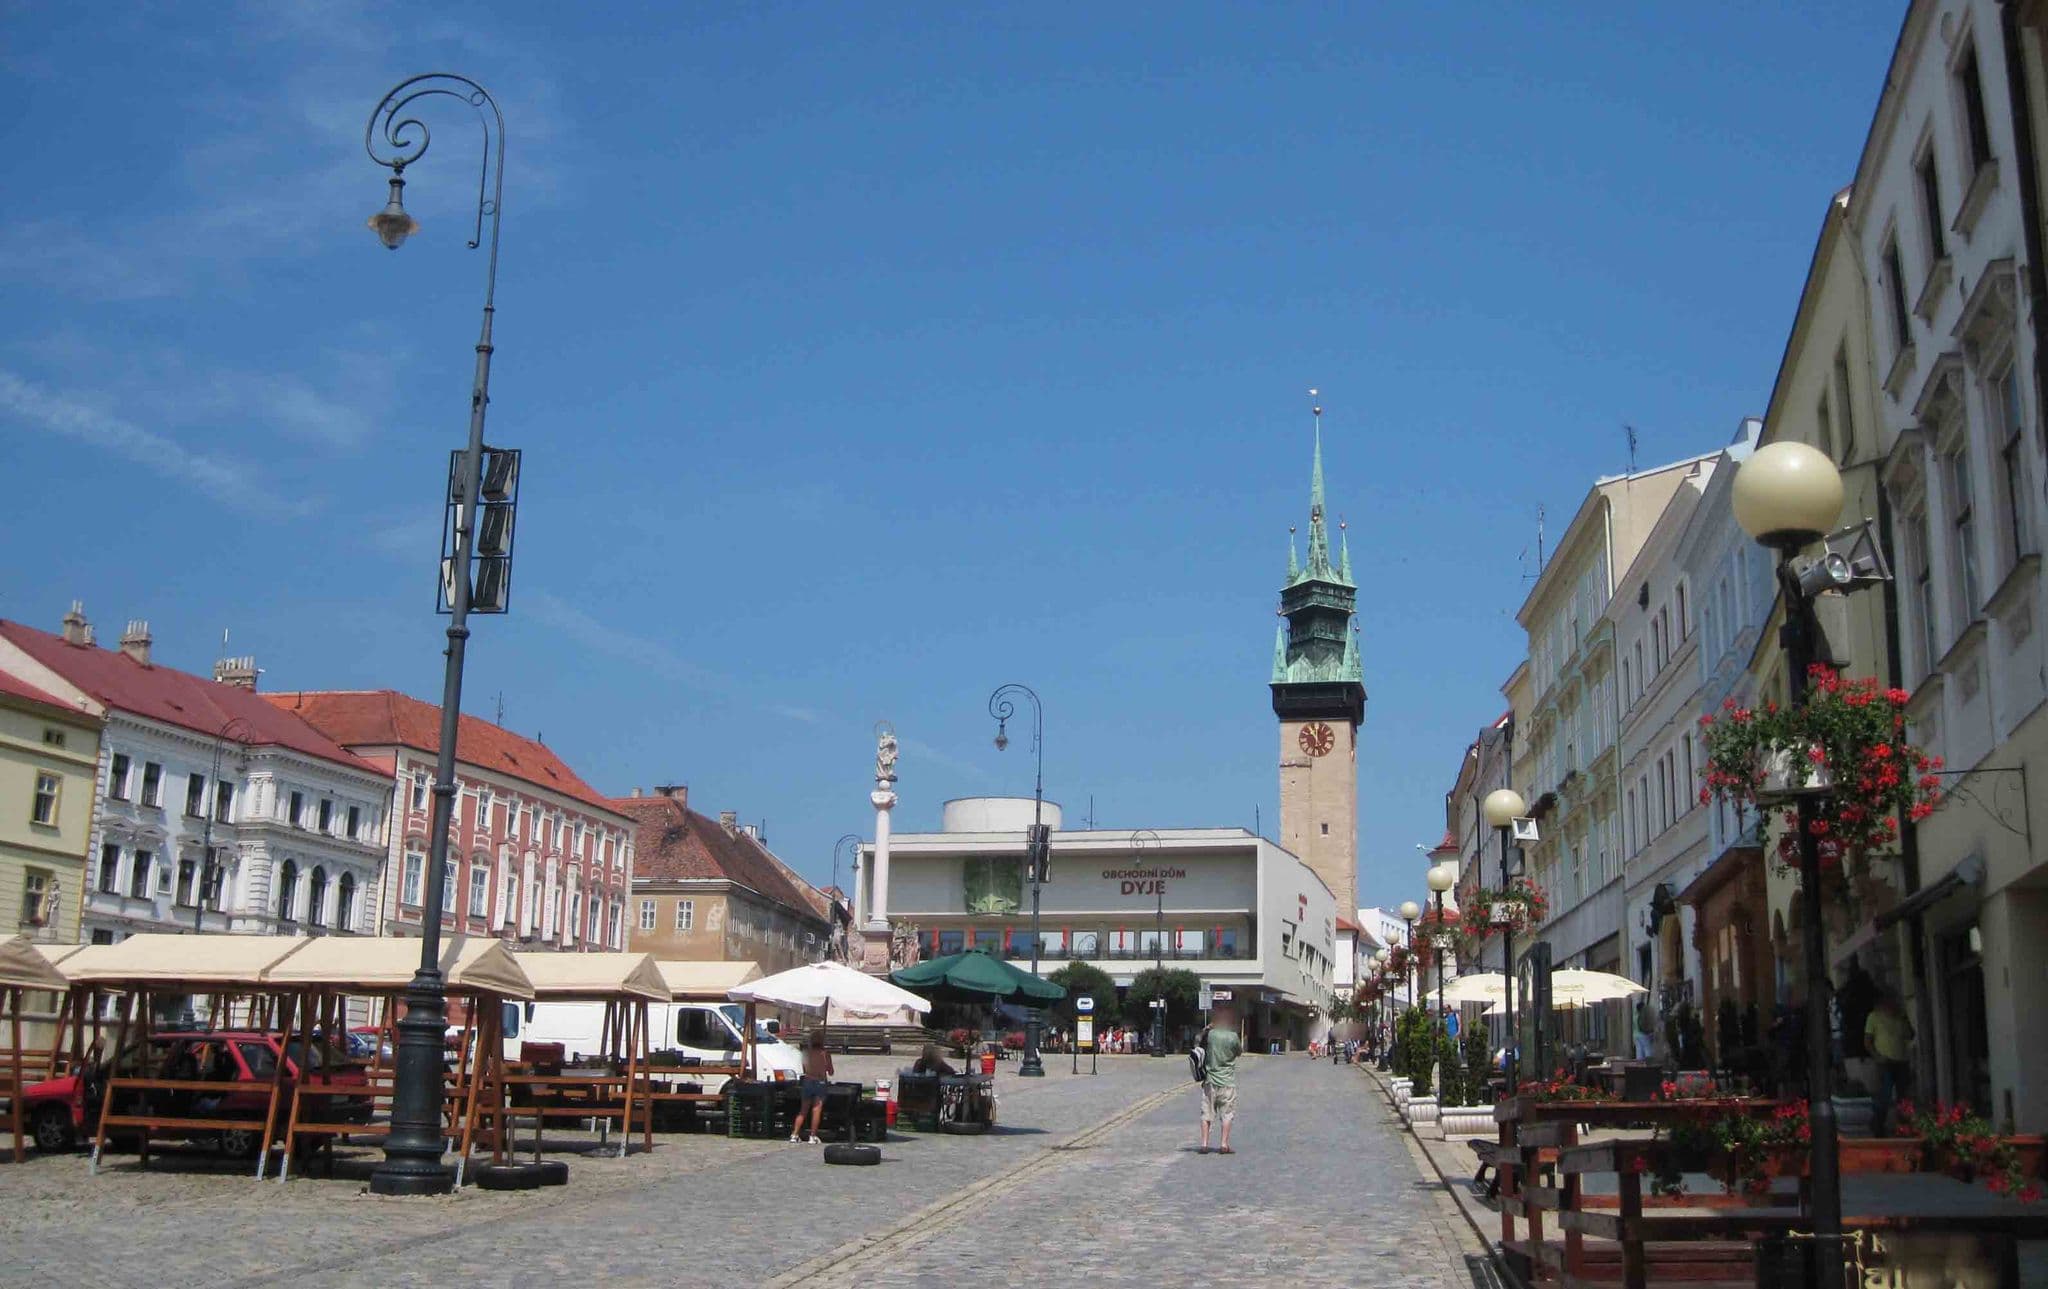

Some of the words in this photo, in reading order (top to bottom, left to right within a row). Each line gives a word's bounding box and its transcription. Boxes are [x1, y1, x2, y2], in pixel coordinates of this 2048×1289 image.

[1102, 867, 1158, 879] OBCHODNÍ
[1160, 866, 1186, 879] DŮM
[1121, 880, 1166, 895] DYJE
